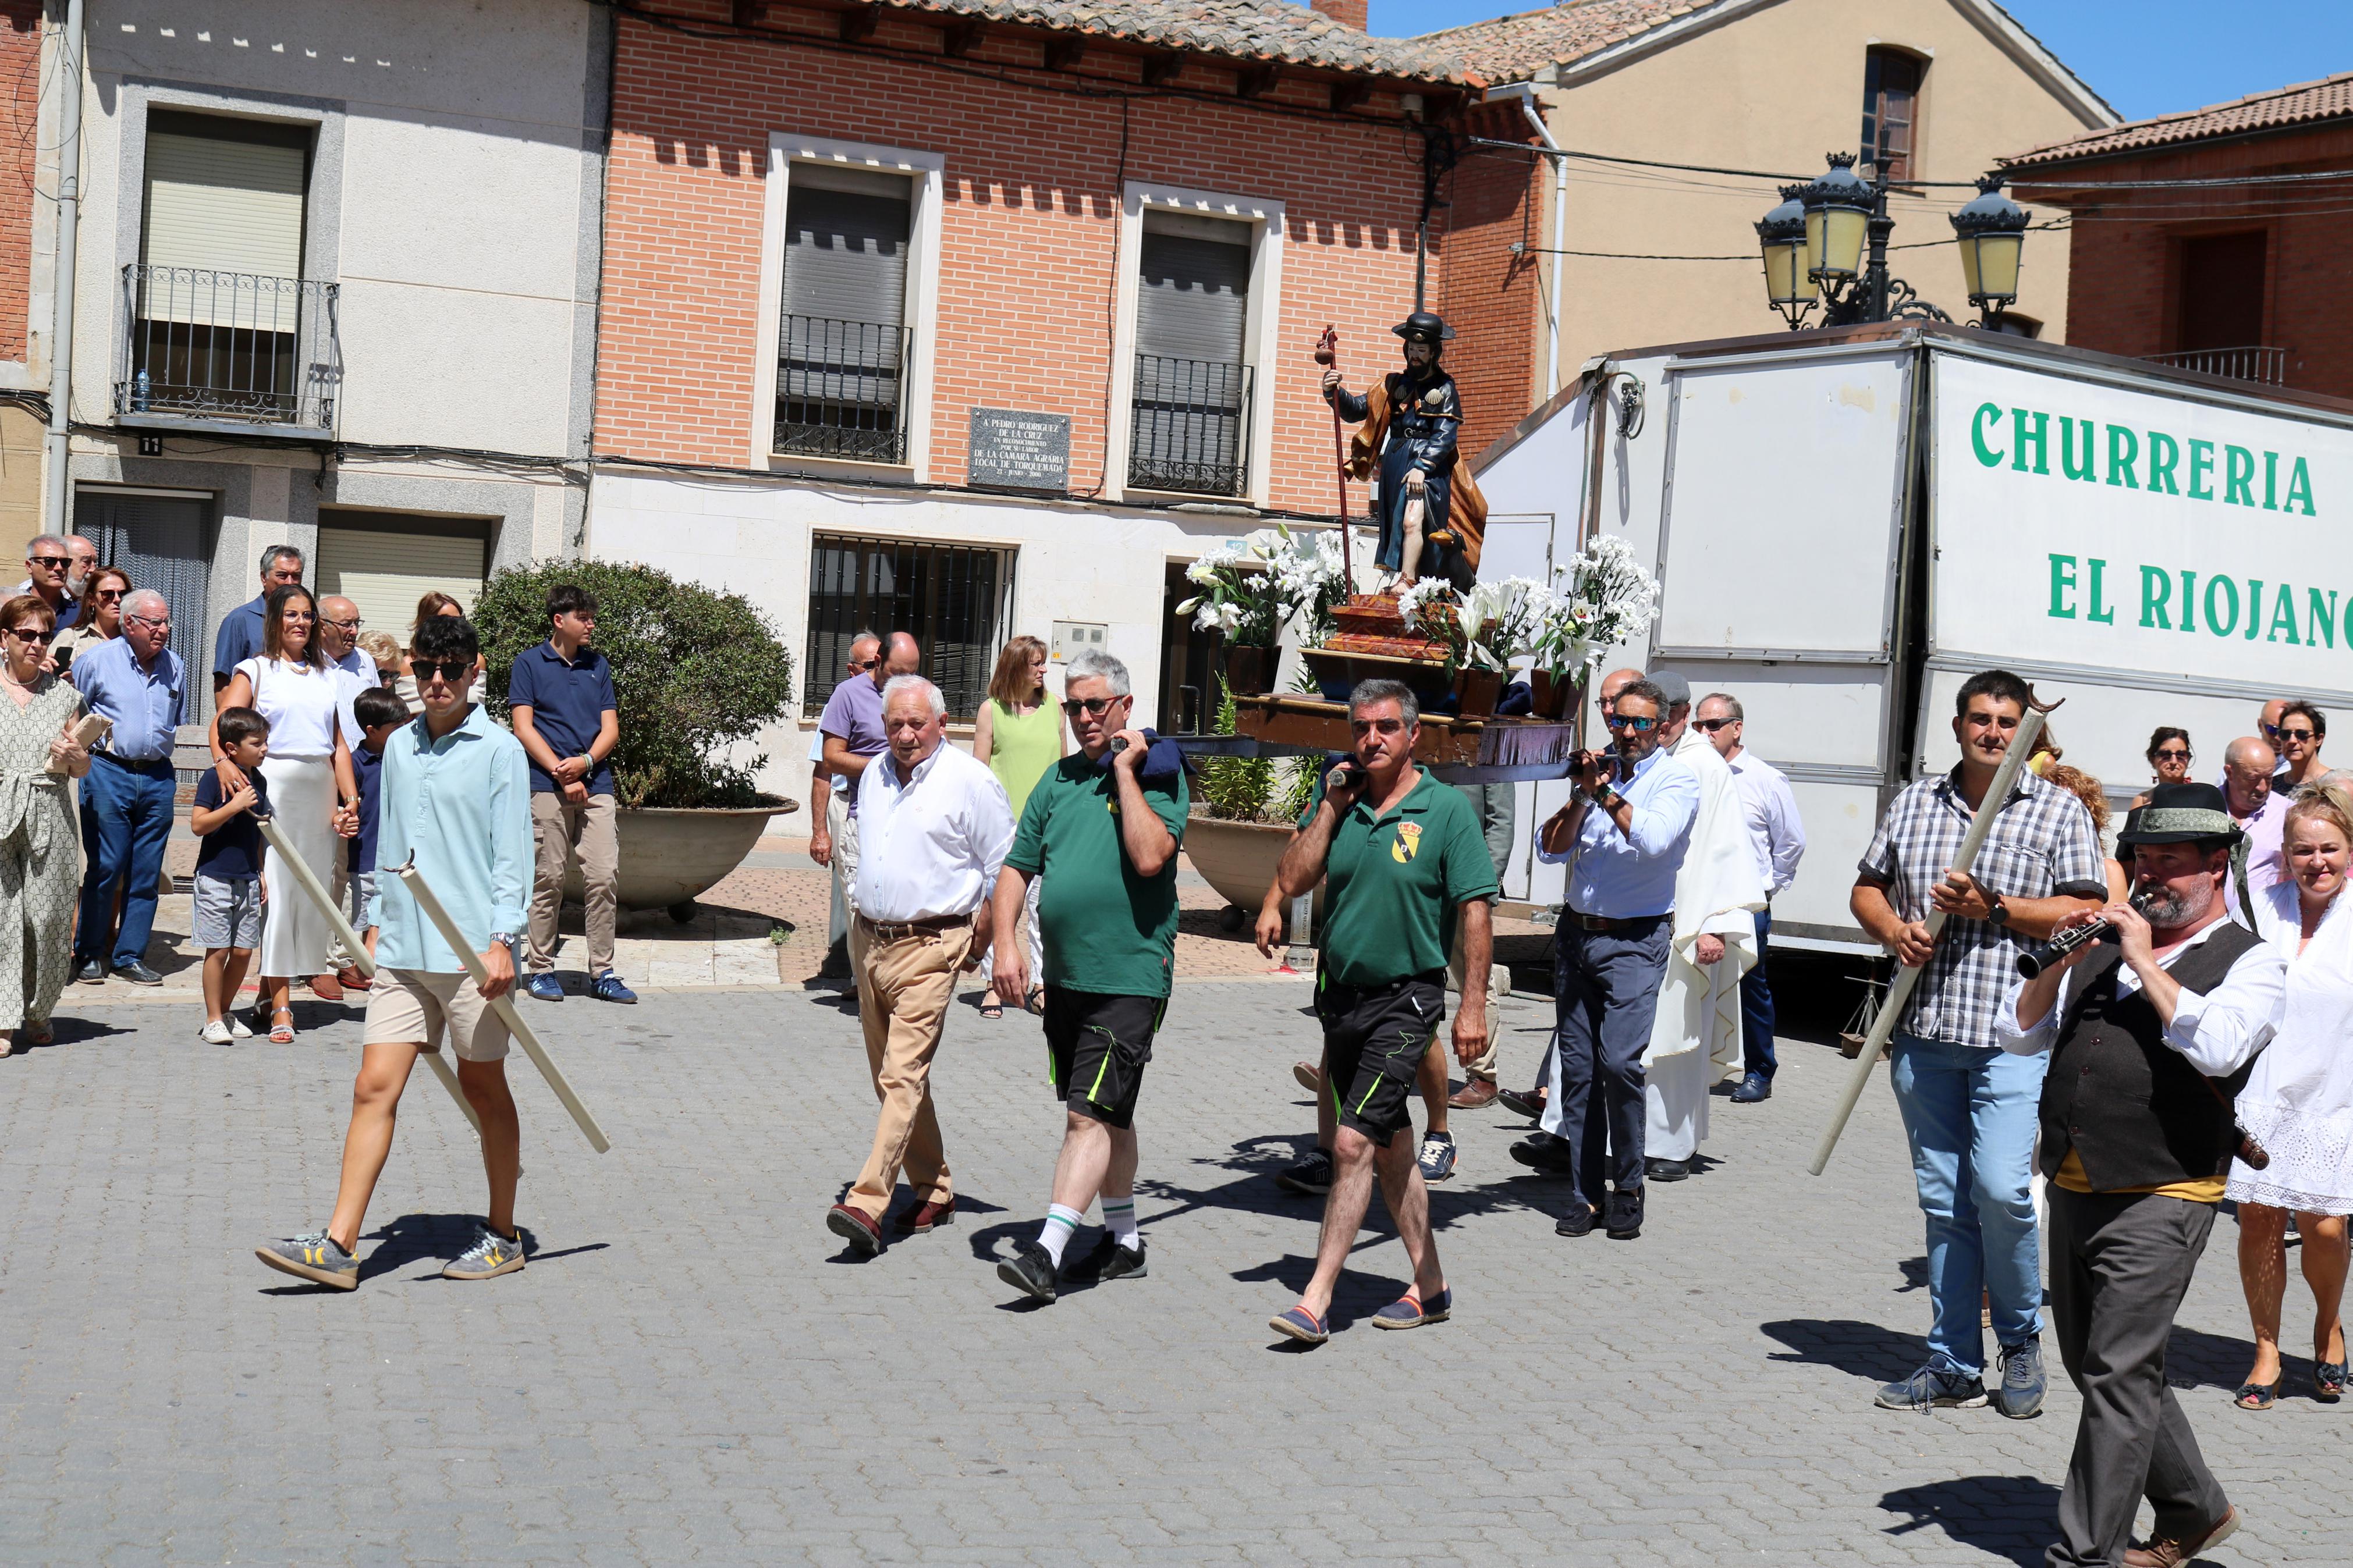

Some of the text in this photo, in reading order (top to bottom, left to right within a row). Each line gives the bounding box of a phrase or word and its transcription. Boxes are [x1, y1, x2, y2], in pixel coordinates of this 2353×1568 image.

[992, 419, 1016, 429] PEDRO
[1018, 421, 1059, 432] RODRIGUEZ
[999, 429, 1042, 439] DE LA CRUZ
[142, 438, 158, 452] 11
[1003, 438, 1046, 446] RECONOCIMIENTO
[987, 450, 996, 458] LA
[999, 451, 1030, 461] CAMARA
[1033, 454, 1064, 464] AGRARIA
[1971, 402, 2316, 517] CHURRERIA
[975, 458, 1063, 472] LOCAL DE TORQUEMADA
[2047, 553, 2353, 651] EL RIOJAN
